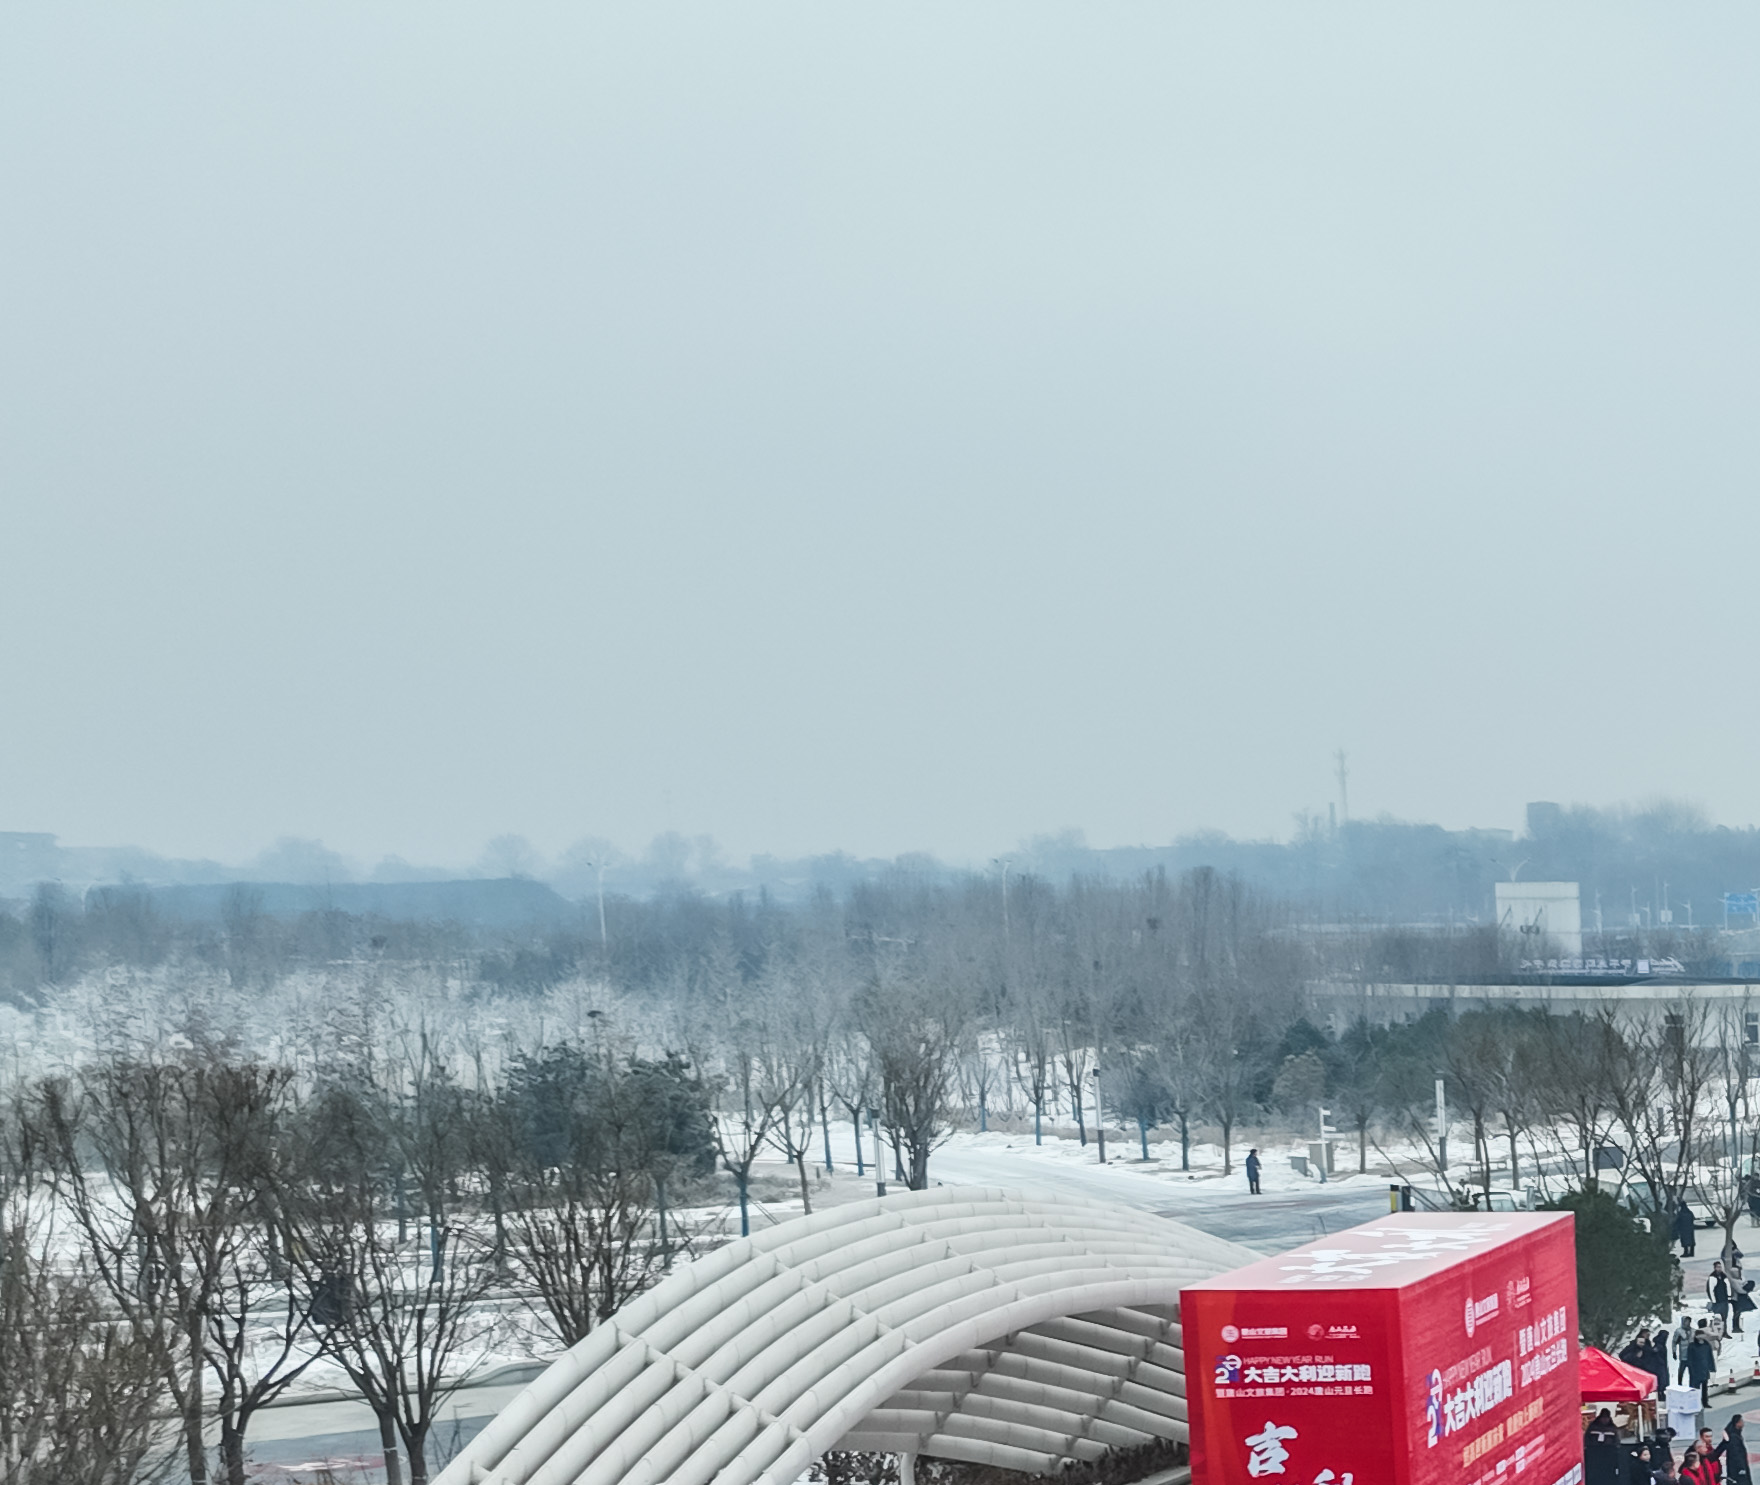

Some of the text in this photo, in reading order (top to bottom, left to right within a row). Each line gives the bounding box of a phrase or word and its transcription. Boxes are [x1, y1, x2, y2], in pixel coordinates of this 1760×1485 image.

[1244, 1364, 1371, 1383] 大吉大利迎新跑
